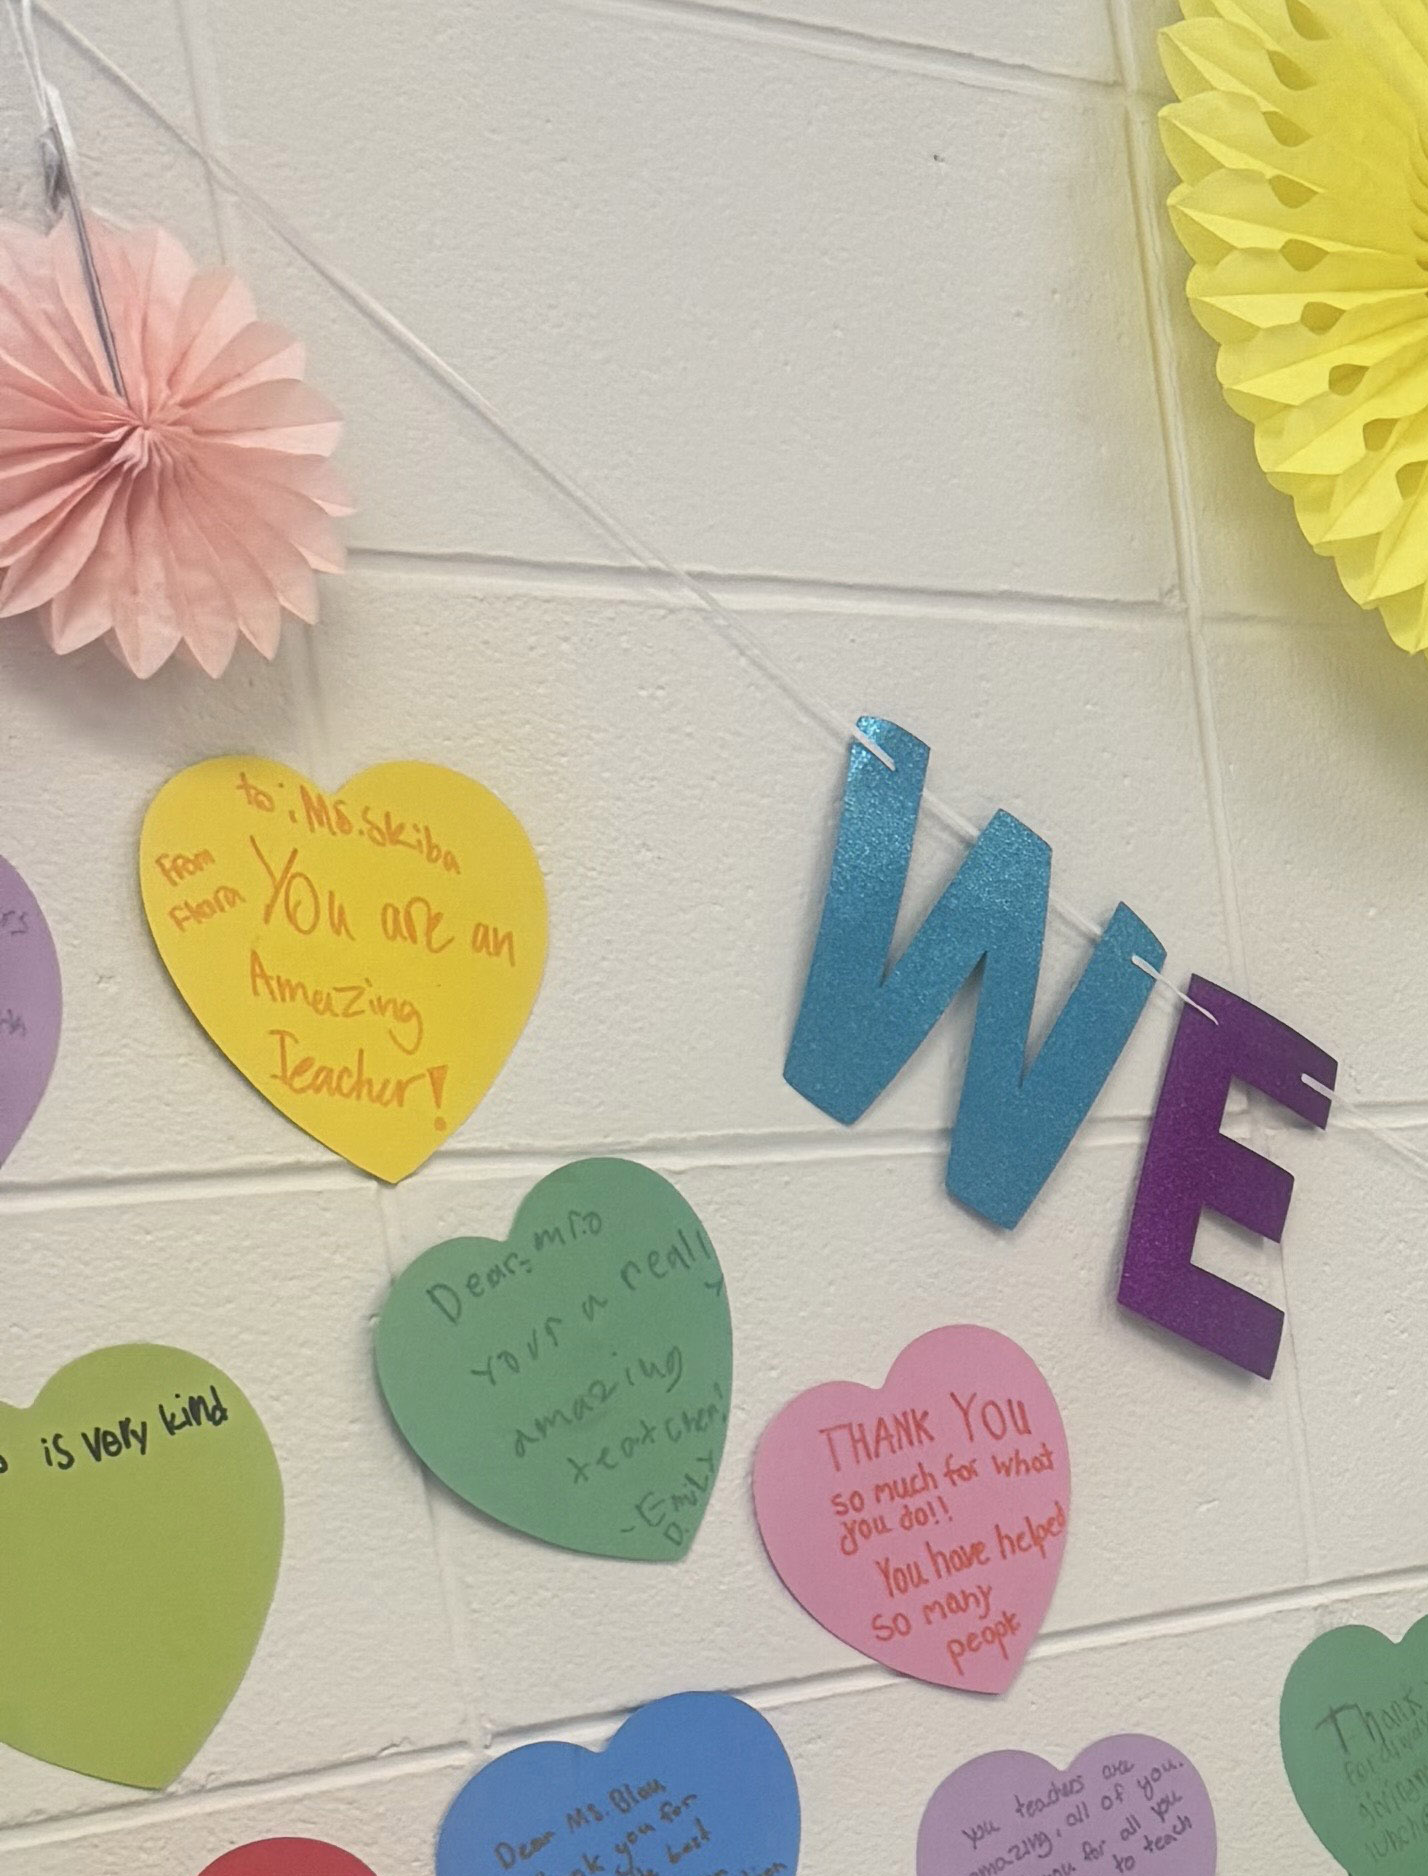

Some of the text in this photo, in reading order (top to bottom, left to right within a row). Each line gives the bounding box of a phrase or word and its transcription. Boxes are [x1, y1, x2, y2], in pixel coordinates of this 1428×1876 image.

[381, 896, 455, 954] are
[471, 923, 515, 967] an
[250, 950, 424, 1055] Amazing
[783, 715, 1338, 1381] WE
[40, 1433, 75, 1470] is
[81, 1417, 147, 1462] very
[158, 1385, 228, 1436] kind
[819, 1391, 1031, 1472] THANK YOU
[874, 1462, 938, 1503] much
[944, 1453, 978, 1487] for
[839, 1496, 953, 1556] you do!!
[875, 1501, 1065, 1599] You have helped
[923, 1585, 992, 1626] many
[1315, 1686, 1422, 1754] Thank
[1065, 1801, 1091, 1829] all
[1100, 1784, 1125, 1812] of
[1120, 1815, 1142, 1842] all
[1151, 1791, 1184, 1823] you
[494, 1829, 556, 1871] Dear
[1112, 1853, 1136, 1874] to
[1143, 1814, 1192, 1854] teach
